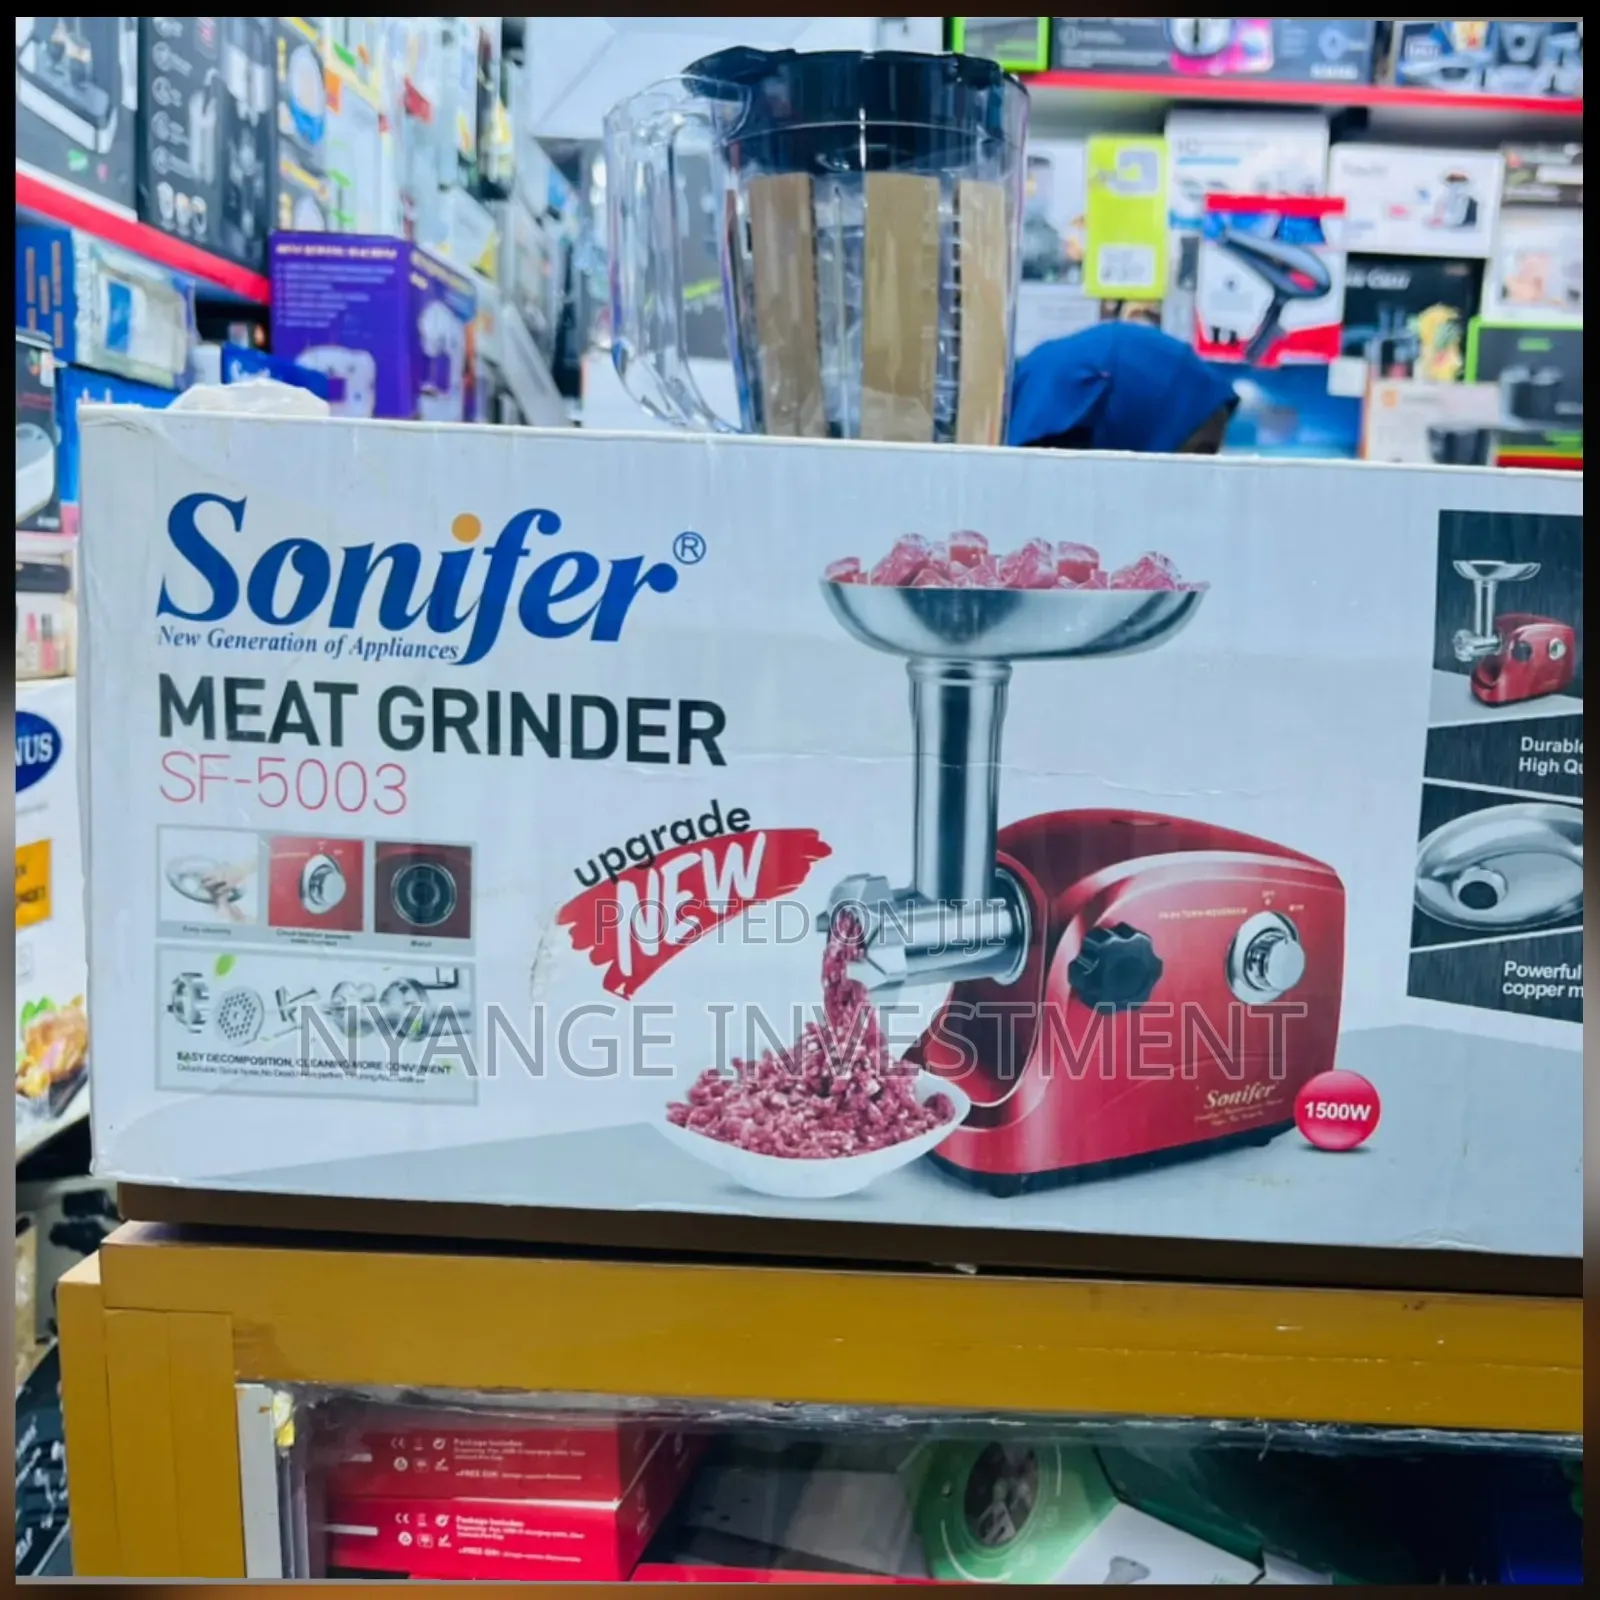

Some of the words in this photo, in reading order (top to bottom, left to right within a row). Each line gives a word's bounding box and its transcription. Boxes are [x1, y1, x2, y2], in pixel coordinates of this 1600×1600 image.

[156, 492, 678, 665] Sonifer
[157, 624, 202, 648] New
[207, 628, 317, 653] Generation
[324, 635, 348, 660] of
[349, 636, 458, 661] Appliances
[159, 673, 359, 747] MEAT
[378, 685, 727, 766] GRINDER
[1519, 757, 1559, 776] High
[160, 751, 407, 815] SF-5003
[574, 799, 751, 887] upgrade
[616, 832, 766, 977] NEW
[1504, 961, 1582, 980] Powerful
[1502, 982, 1566, 1000] copper
[177, 1051, 204, 1063] EASY
[296, 1057, 349, 1069] CLEANING
[353, 1059, 383, 1071] MORE
[1204, 1081, 1276, 1109] Sonifer
[1305, 1101, 1372, 1121] 1500W
